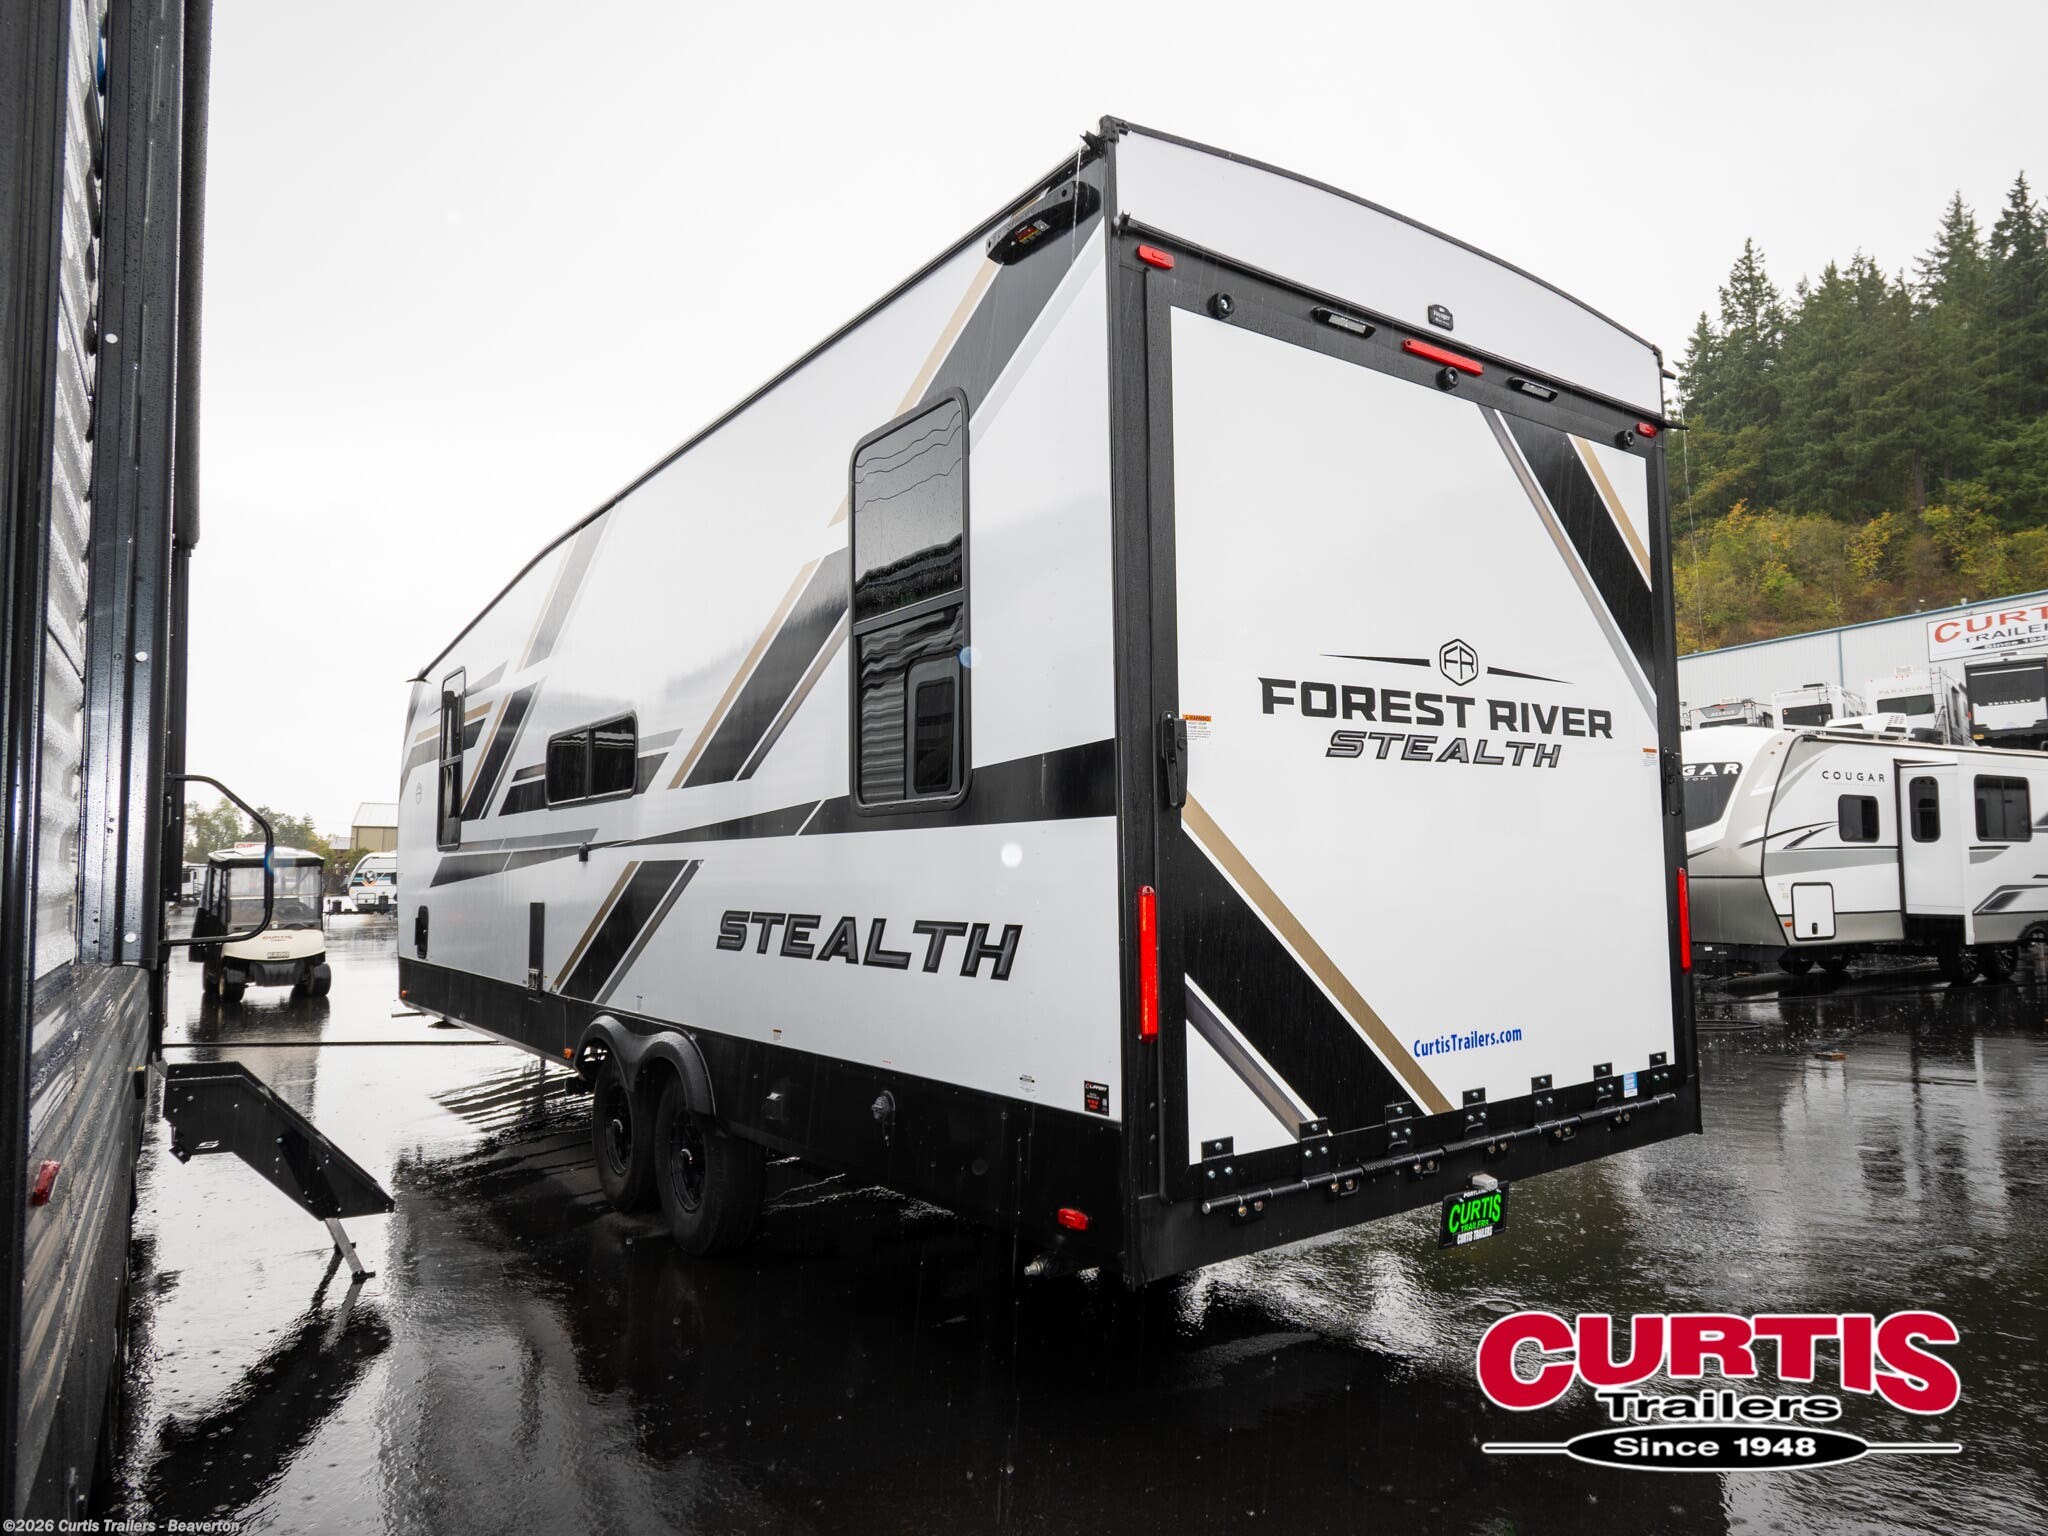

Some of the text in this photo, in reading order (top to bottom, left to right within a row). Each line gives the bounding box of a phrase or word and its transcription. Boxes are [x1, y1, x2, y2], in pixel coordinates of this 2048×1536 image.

[1965, 623, 2048, 643] TRAILE
[1258, 677, 1613, 739] FOREST RIVER
[1325, 730, 1562, 769] STEALTH
[1822, 770, 1886, 782] COUGAR
[716, 910, 1023, 981] STEALTH
[1413, 1026, 1523, 1059] CurtisTrailers.com
[1449, 1194, 1502, 1233] CURTIS
[1461, 1219, 1489, 1232] TRAILERS
[1457, 1225, 1493, 1246] CURTIS TRAILERS
